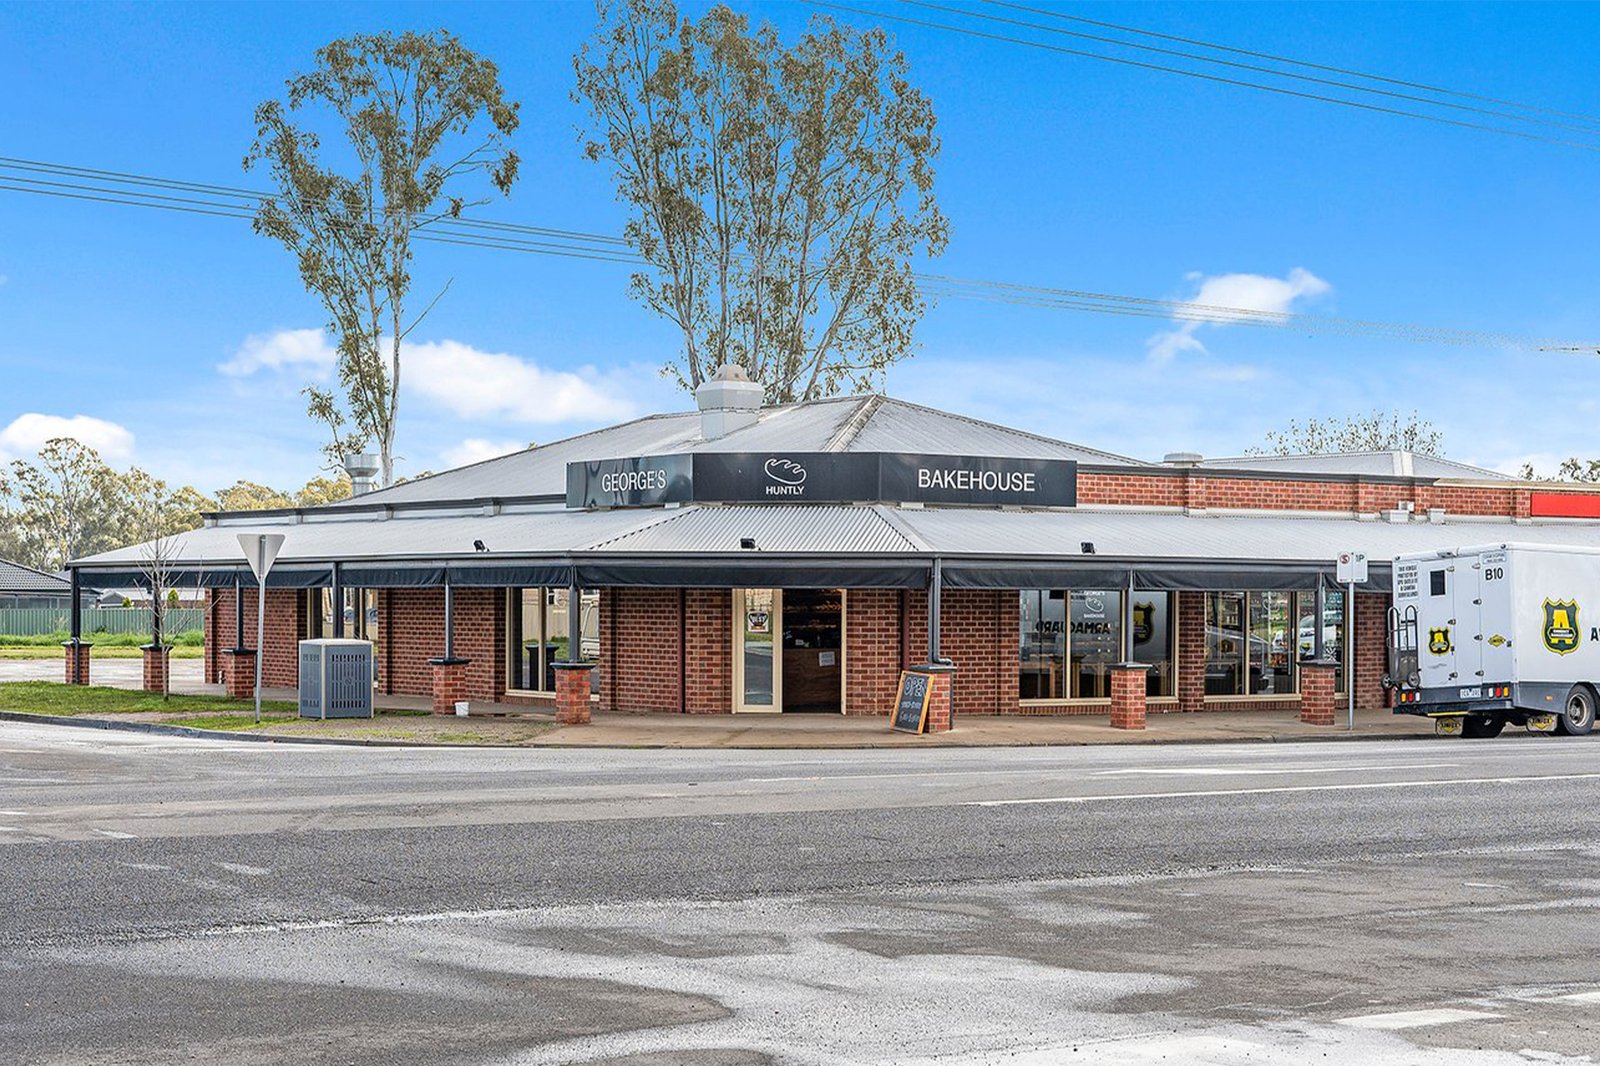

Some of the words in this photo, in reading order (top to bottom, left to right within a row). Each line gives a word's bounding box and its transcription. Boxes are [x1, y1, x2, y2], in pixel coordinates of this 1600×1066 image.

[602, 469, 666, 492] GEORGE'S
[918, 468, 1036, 492] BAKEHOUSE
[765, 486, 805, 495] HUNTLY
[1485, 567, 1504, 581] B10
[1590, 627, 1600, 641] A
